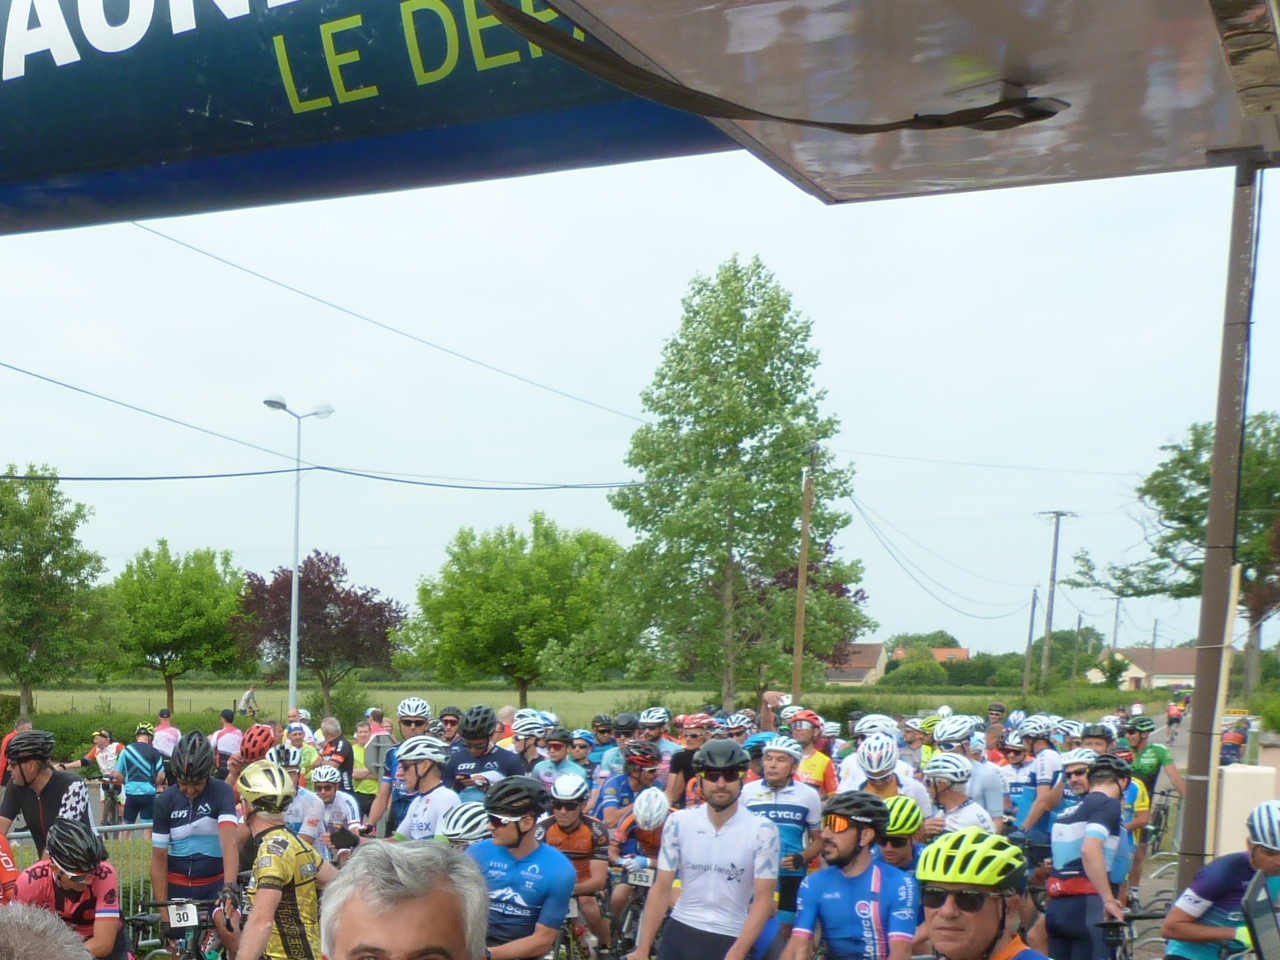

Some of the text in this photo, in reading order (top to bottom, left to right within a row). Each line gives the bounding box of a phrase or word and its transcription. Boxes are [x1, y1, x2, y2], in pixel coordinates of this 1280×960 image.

[273, 14, 379, 114] LE
[768, 810, 803, 820] CYCLO
[632, 872, 650, 884] 153
[175, 911, 190, 923] 30
